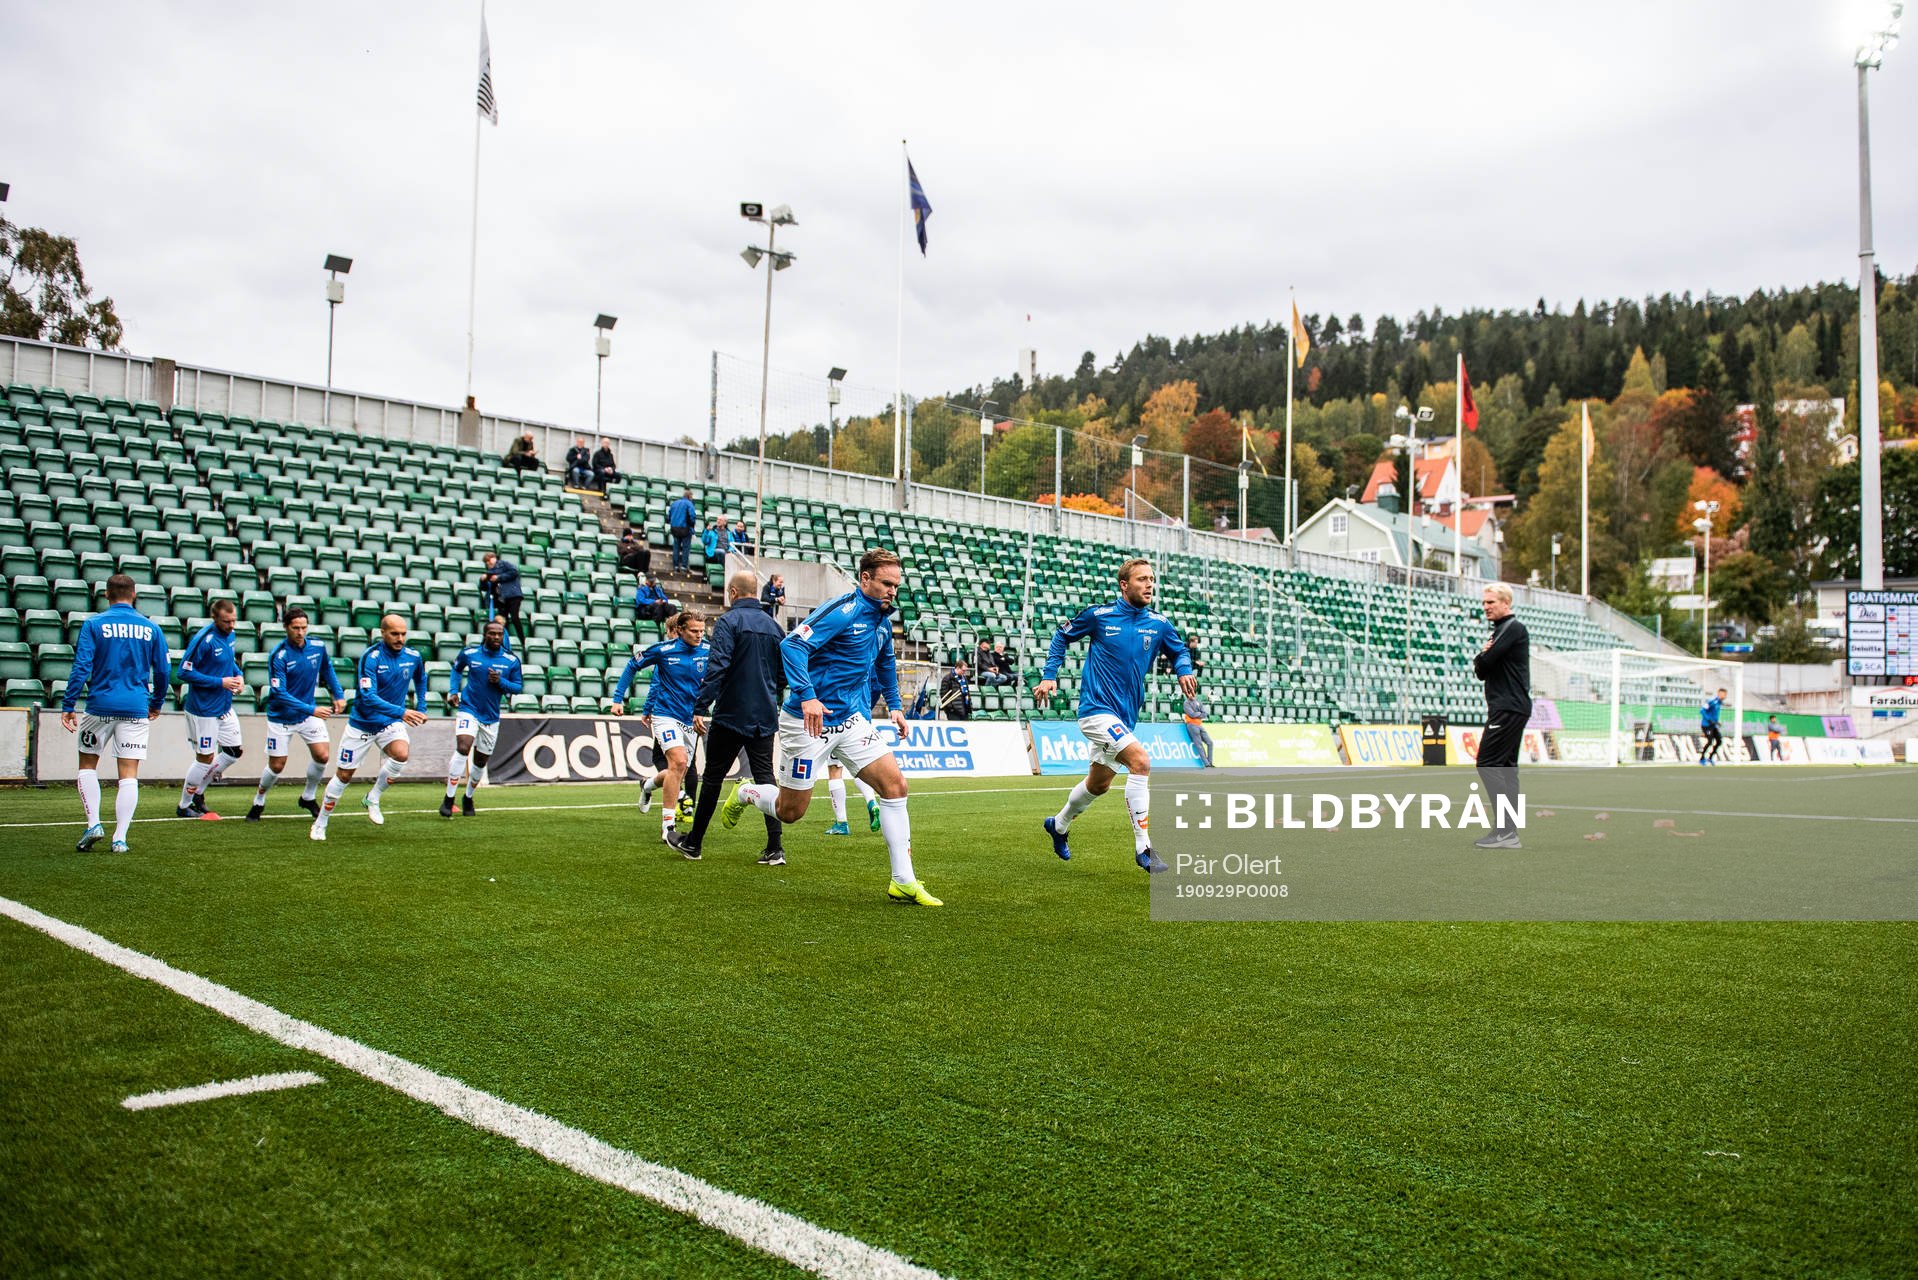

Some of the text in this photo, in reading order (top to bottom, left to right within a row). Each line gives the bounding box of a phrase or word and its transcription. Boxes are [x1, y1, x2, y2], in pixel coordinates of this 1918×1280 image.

[102, 623, 153, 641] SIRIUS
[1870, 696, 1918, 704] Faradiu
[1041, 734, 1091, 761] Arka
[1354, 730, 1393, 762] CITY
[896, 753, 968, 769] eknik ab
